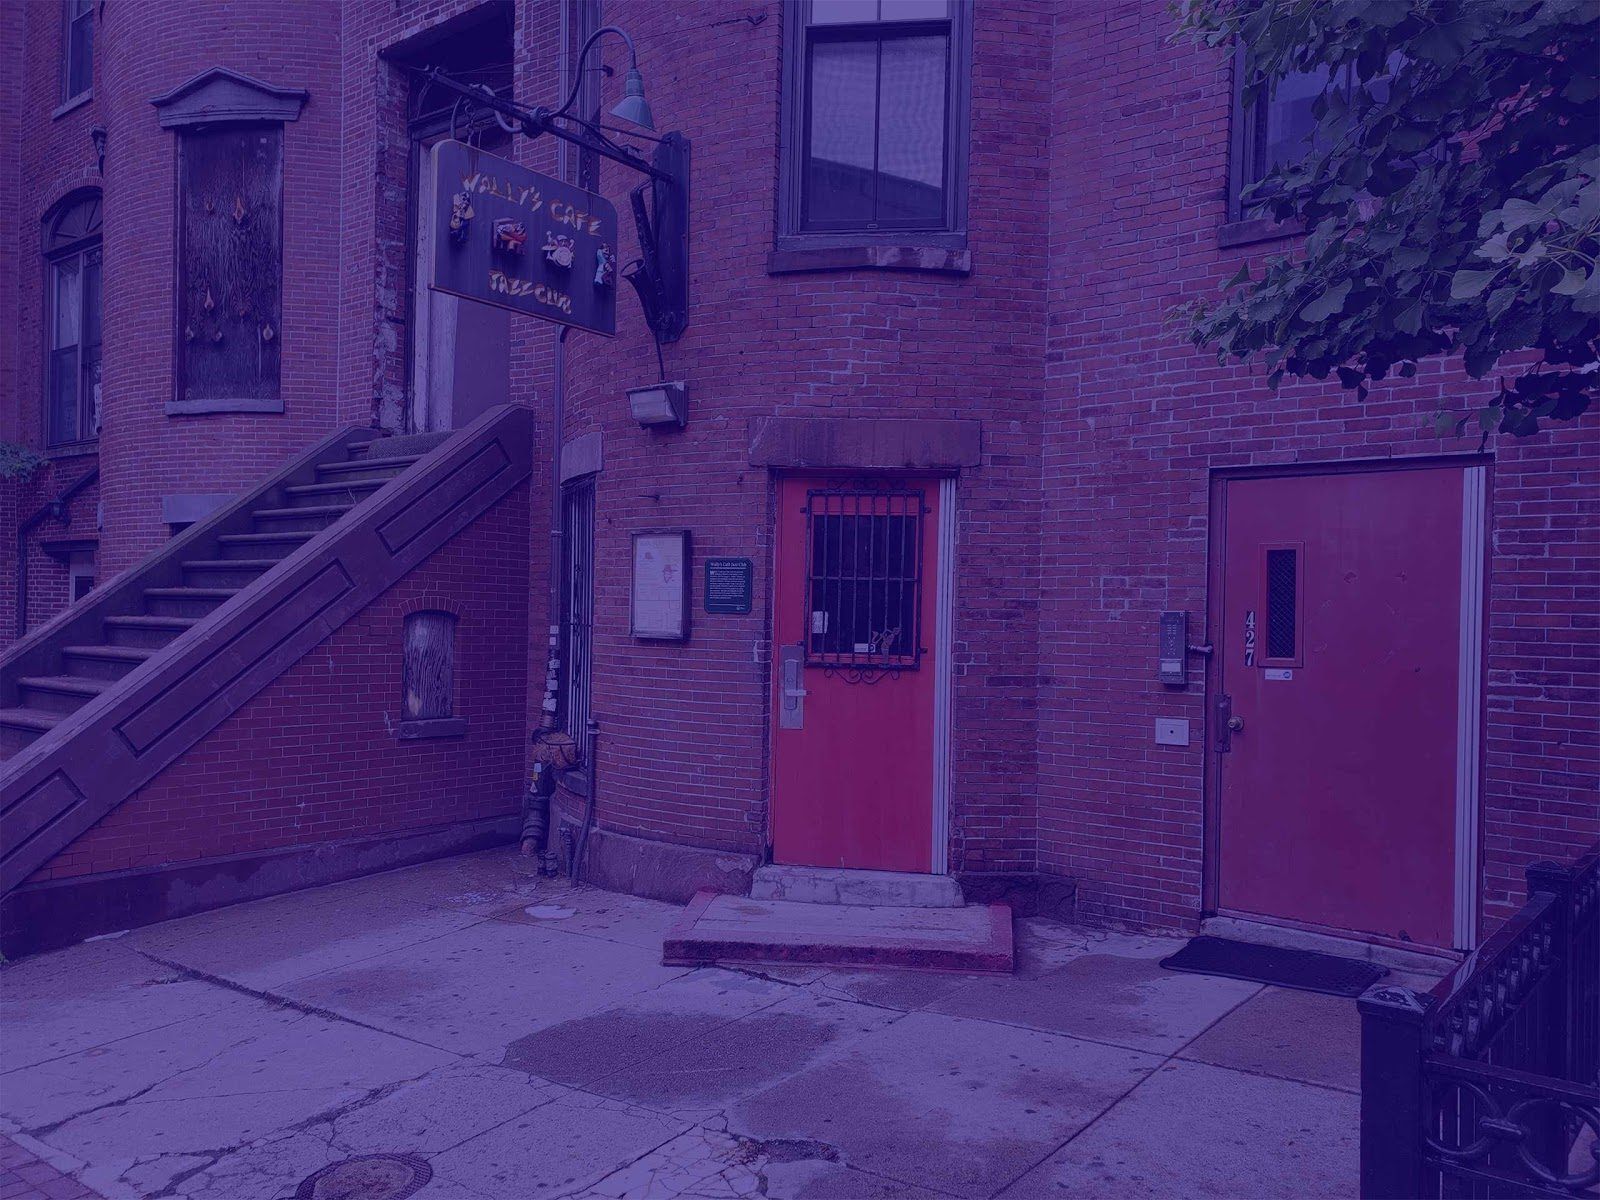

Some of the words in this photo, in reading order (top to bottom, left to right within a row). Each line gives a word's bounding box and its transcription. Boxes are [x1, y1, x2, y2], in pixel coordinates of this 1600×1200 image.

[459, 169, 543, 212] WALLY'S
[549, 199, 602, 237] CAFE
[488, 269, 534, 298] JAZZ
[534, 283, 572, 315] CLUB
[1245, 611, 1255, 666] 427
